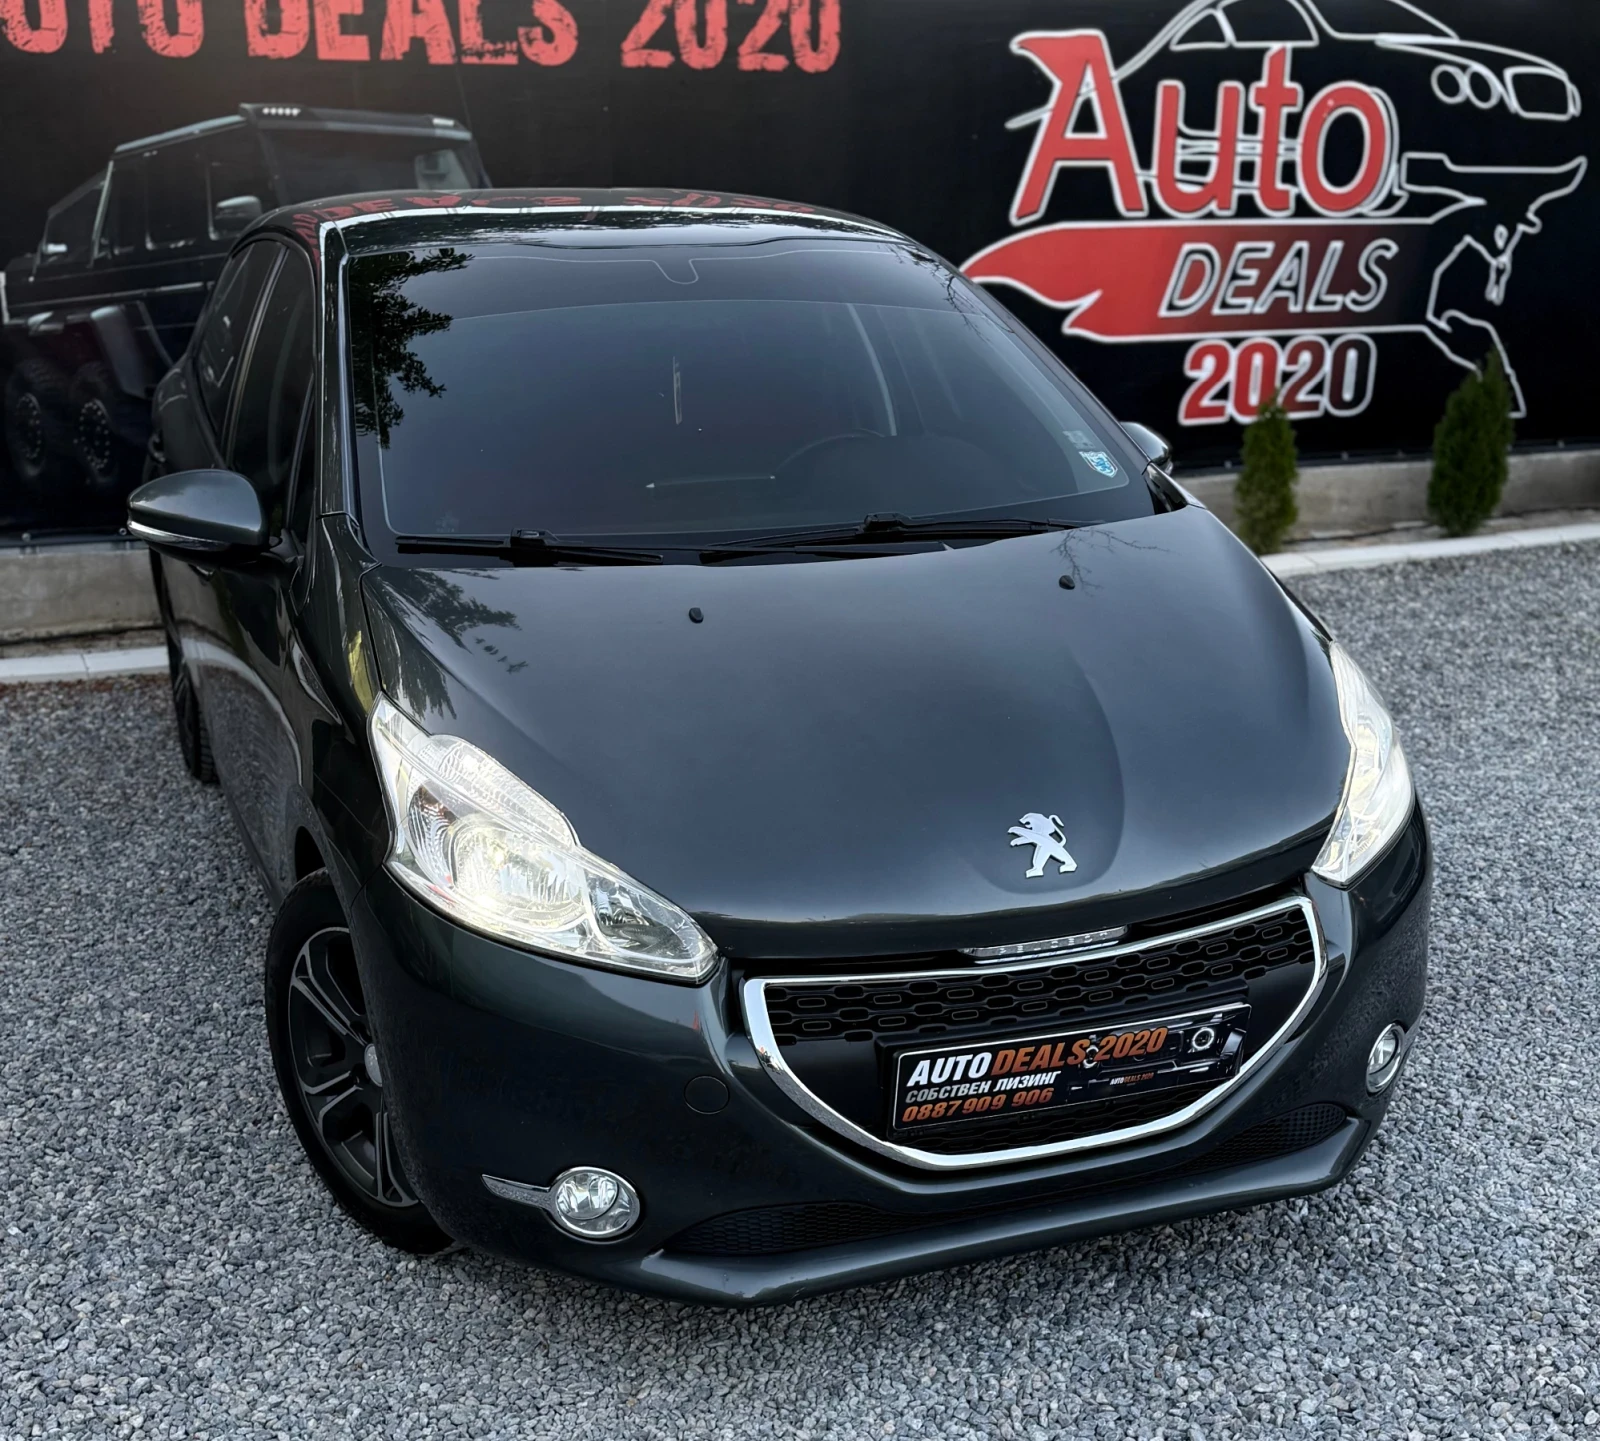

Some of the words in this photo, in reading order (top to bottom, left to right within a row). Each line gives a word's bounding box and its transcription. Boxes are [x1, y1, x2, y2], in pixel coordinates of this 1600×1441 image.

[1010, 30, 1394, 225] Auto
[1158, 239, 1399, 317] DEALS
[1178, 333, 1377, 425] 2020
[1093, 1026, 1168, 1061] 2020
[905, 1080, 992, 1103] СОБСТВЕН
[993, 1070, 1061, 1092] ЛИЗИНГ
[1011, 1087, 1054, 1107] 906
